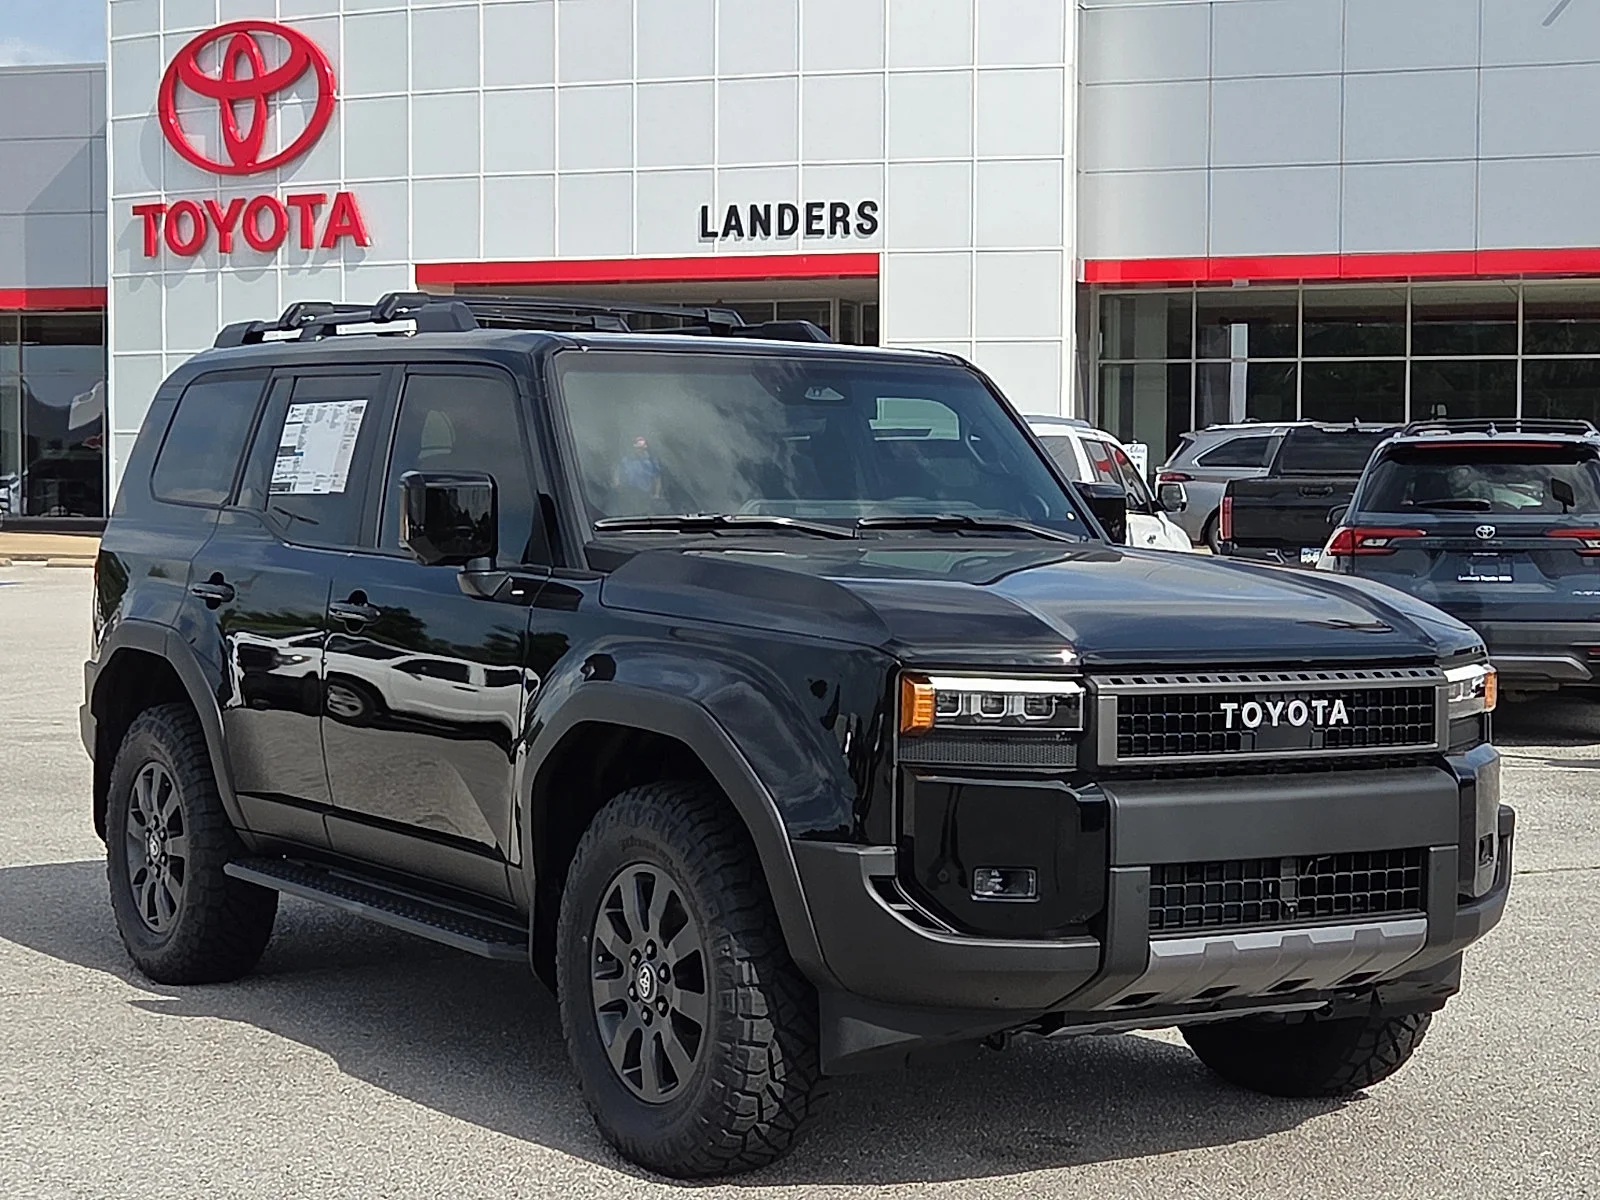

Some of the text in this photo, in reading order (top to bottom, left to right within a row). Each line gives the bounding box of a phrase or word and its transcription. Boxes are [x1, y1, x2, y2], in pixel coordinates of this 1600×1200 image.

[132, 191, 371, 257] TOYOTA
[700, 200, 879, 238] LANDERS
[1219, 699, 1350, 729] TOYOTA
